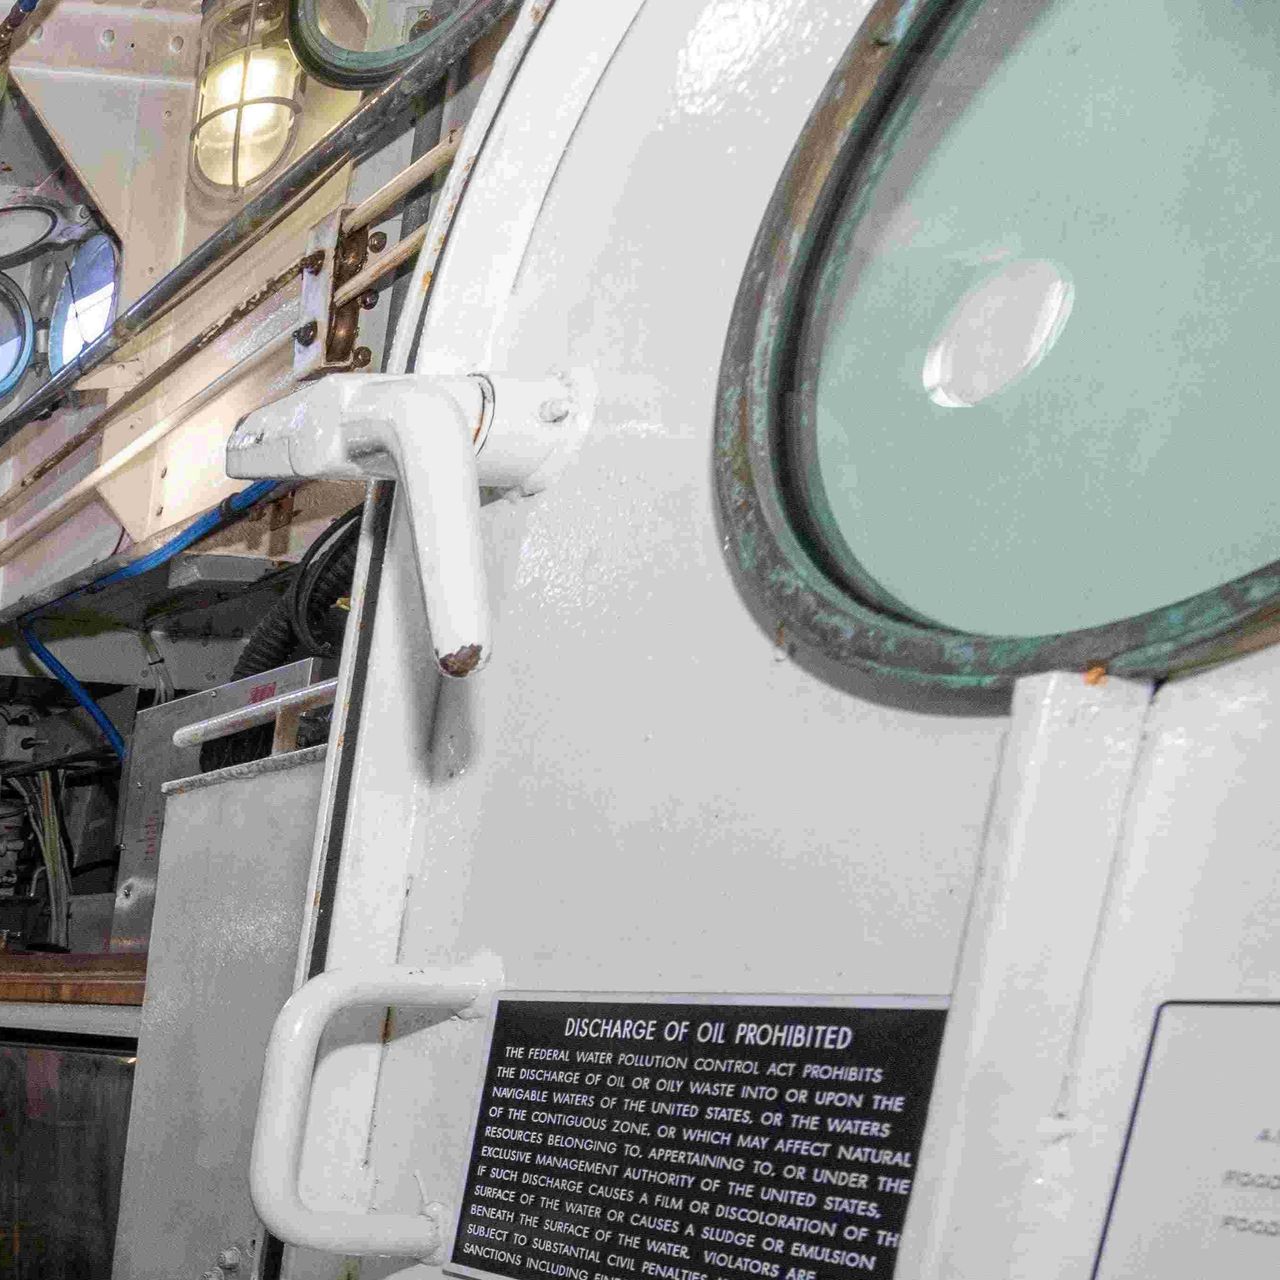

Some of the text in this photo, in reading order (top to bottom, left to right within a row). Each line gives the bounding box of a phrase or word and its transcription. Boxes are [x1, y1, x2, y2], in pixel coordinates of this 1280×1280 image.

[564, 1017, 853, 1050] DISCHARGE OF OIL PROHIBITED
[496, 1065, 905, 1112] THE DISCHARGE OF OIL OR OILY WASTE INTO OR UPON THE
[505, 1046, 883, 1083] THE FEDERAL WATER POLLUTION CONTROL ACT PROHIBITS
[488, 1106, 504, 1118] OF
[508, 1107, 527, 1121] THE
[530, 1111, 607, 1131] CONTIGUOUS
[656, 1125, 676, 1139] OR
[682, 1127, 732, 1145] WHICH
[736, 1134, 770, 1149] MAY
[773, 1138, 832, 1157] AFFECT
[837, 1145, 912, 1168] NATURAL
[491, 1086, 548, 1103] NAVIGABLE
[552, 1091, 595, 1107] WATERS
[599, 1096, 618, 1109] OF
[623, 1098, 647, 1113] THE
[651, 1101, 699, 1118] UNITED
[760, 1111, 783, 1127] OR
[790, 1113, 821, 1130] THE
[826, 1117, 891, 1138] WATERS
[480, 1145, 532, 1164] EXCLUSIVE
[535, 1153, 619, 1176] MANAGEMENT
[623, 1167, 696, 1188] AUTHORITY
[700, 1177, 721, 1192] OF
[727, 1181, 755, 1198] THE
[760, 1186, 817, 1207] UNITED
[484, 1125, 543, 1144] RESOURCES
[547, 1133, 617, 1154] BELONGING
[647, 1147, 745, 1171] APPERTAINING
[782, 1164, 806, 1180] OR
[812, 1167, 869, 1189] UNDER
[877, 1175, 912, 1195] THE
[473, 1184, 877, 1271] SURFACE OF THE WATER OR CAUSES A SLUDGE OR EMULSION
[476, 1164, 901, 1248] IF SUCH DISCHARGE CAUSES A FILM OR DISCOLORATION OF TH
[462, 1242, 522, 1266] SANCTIONS
[466, 1223, 509, 1242] SUBJECT
[513, 1232, 527, 1246] TO
[531, 1237, 600, 1263] SUBSTANTIAL
[606, 1253, 635, 1271] CIVIL
[469, 1203, 515, 1223] BENEATH
[519, 1212, 539, 1228] THE
[543, 1218, 590, 1238] SURFACE
[594, 1229, 612, 1242] OF
[618, 1232, 641, 1249] THE
[646, 1238, 690, 1259] WATER.
[703, 1250, 780, 1278] VIOLATORS
